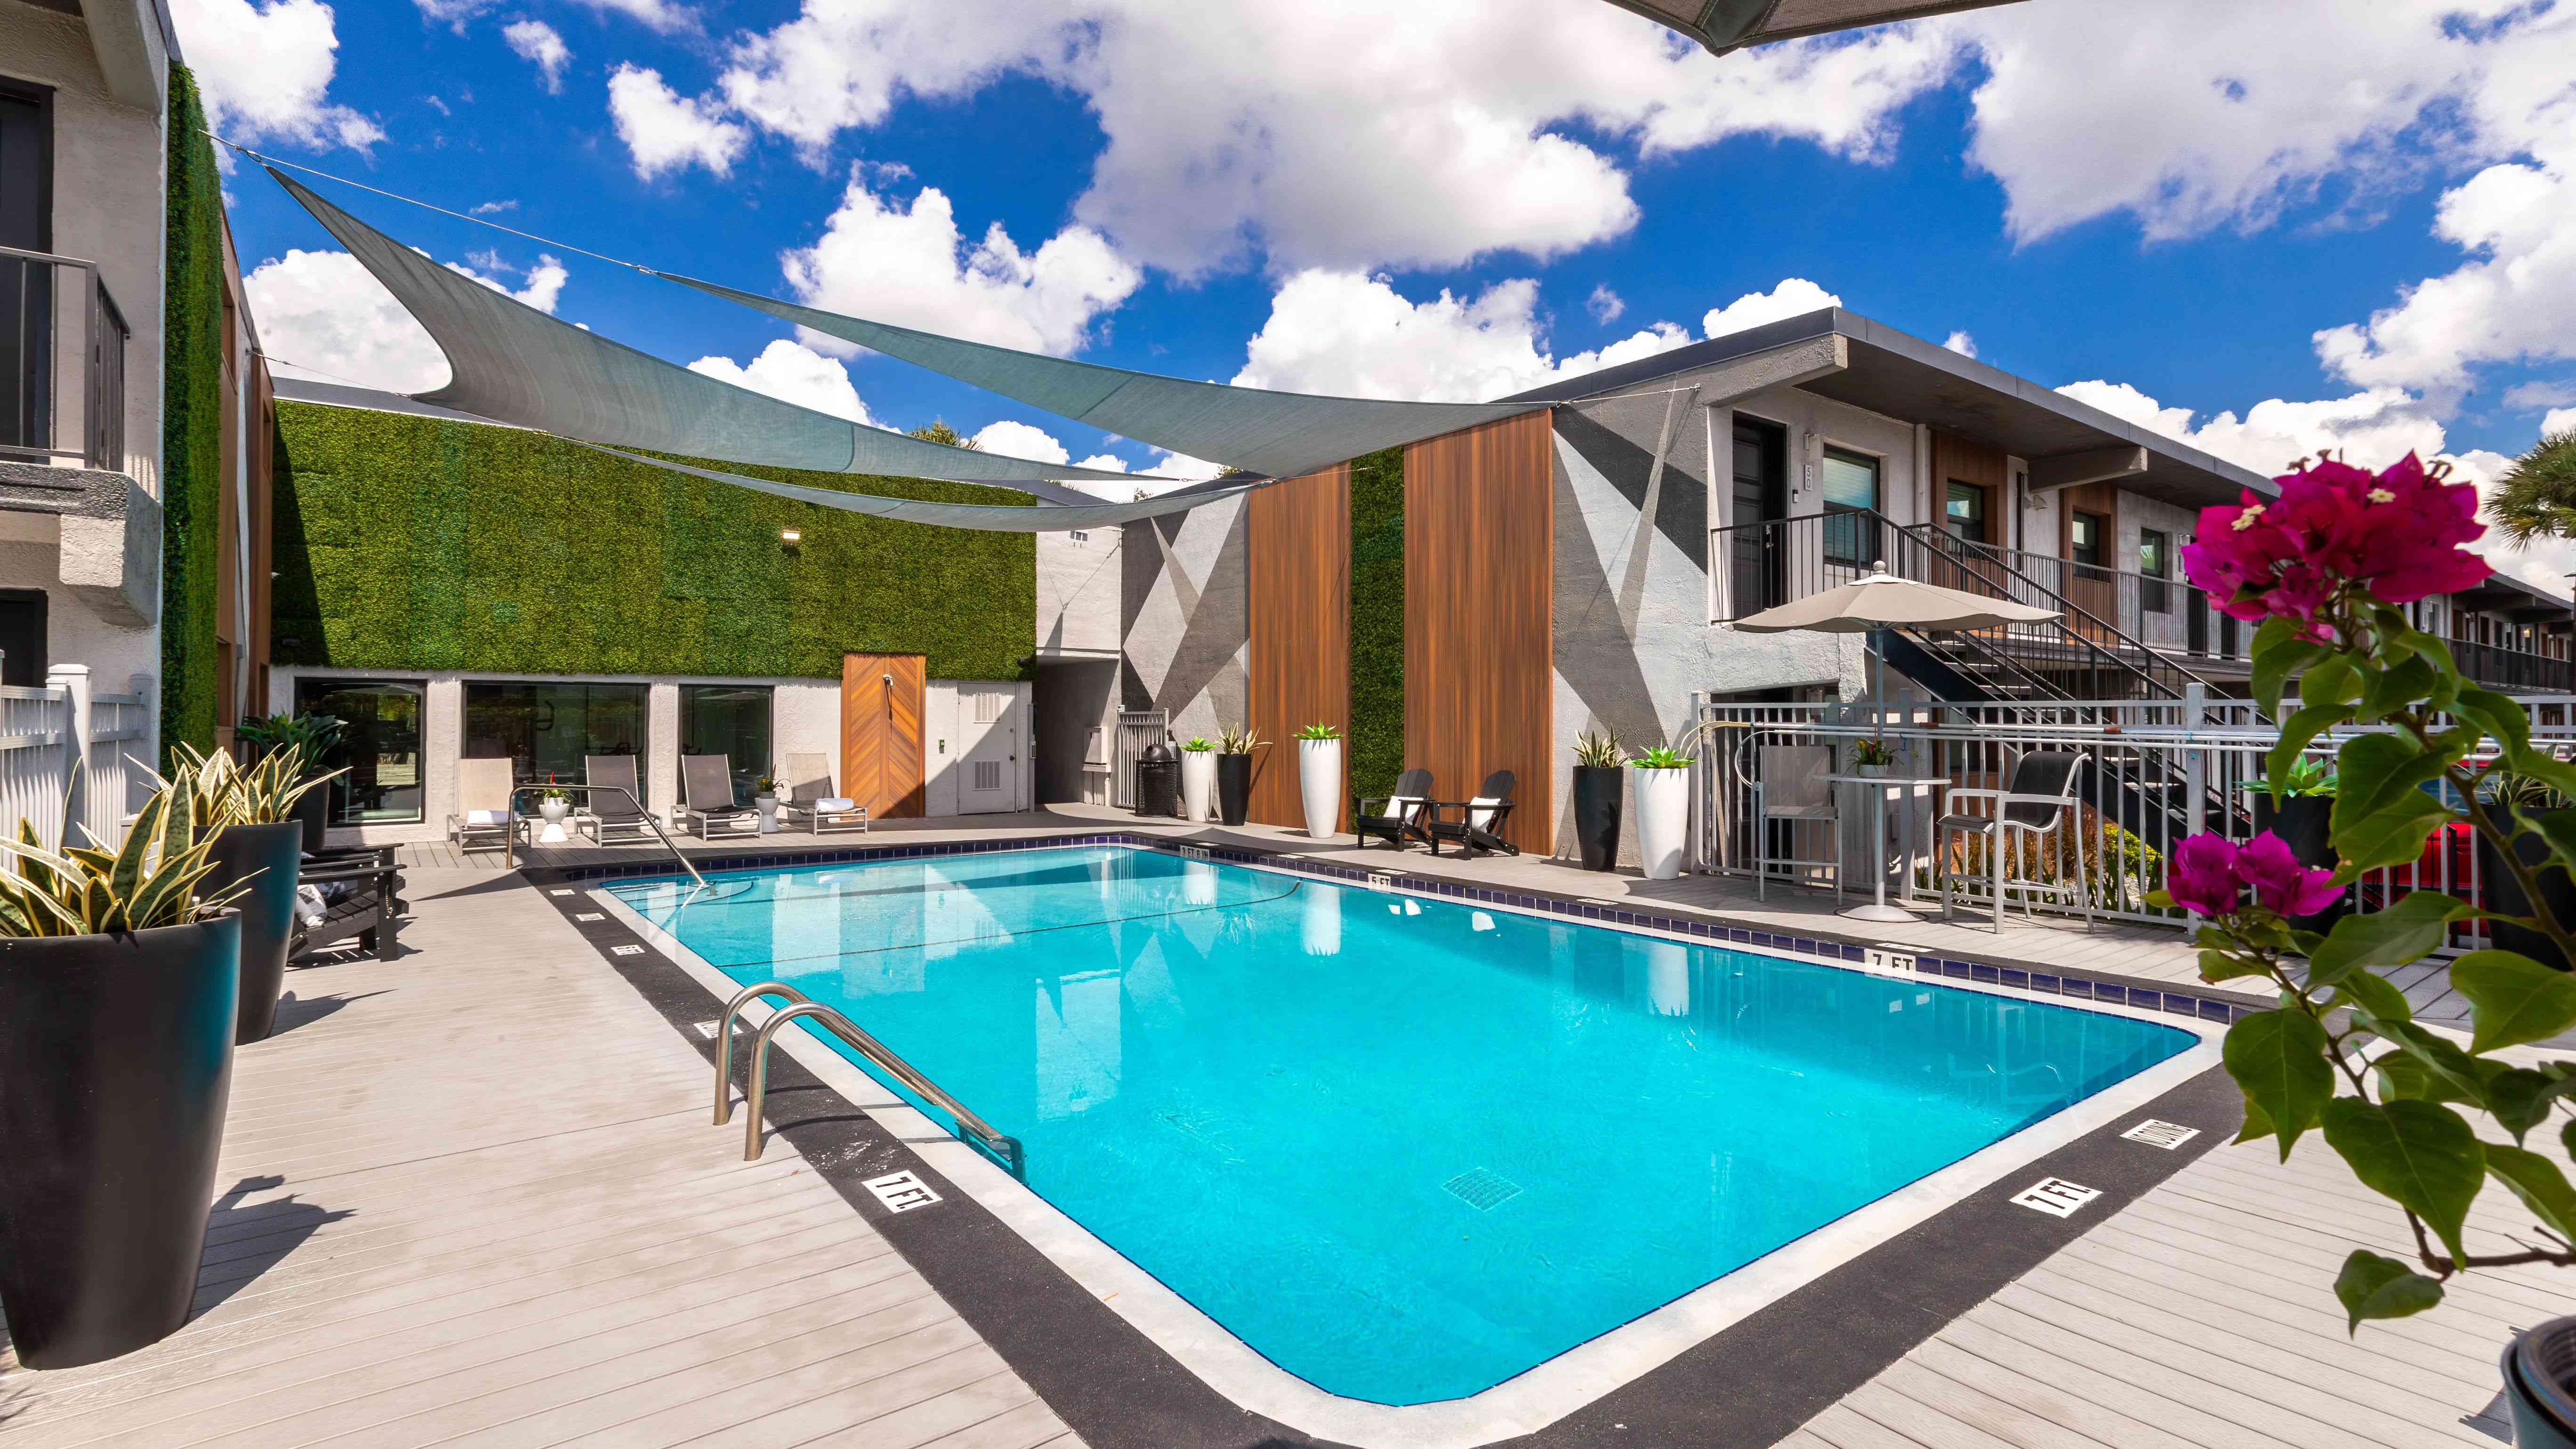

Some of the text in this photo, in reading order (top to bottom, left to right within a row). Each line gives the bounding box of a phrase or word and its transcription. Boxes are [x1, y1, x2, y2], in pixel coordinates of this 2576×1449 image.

[1807, 467, 1811, 488] 50
[1380, 877, 1390, 886] FT
[1873, 953, 1913, 970] 7 FT
[2128, 1133, 2172, 1147] NO
[875, 1176, 912, 1188] 7
[2024, 1194, 2066, 1210] 7
